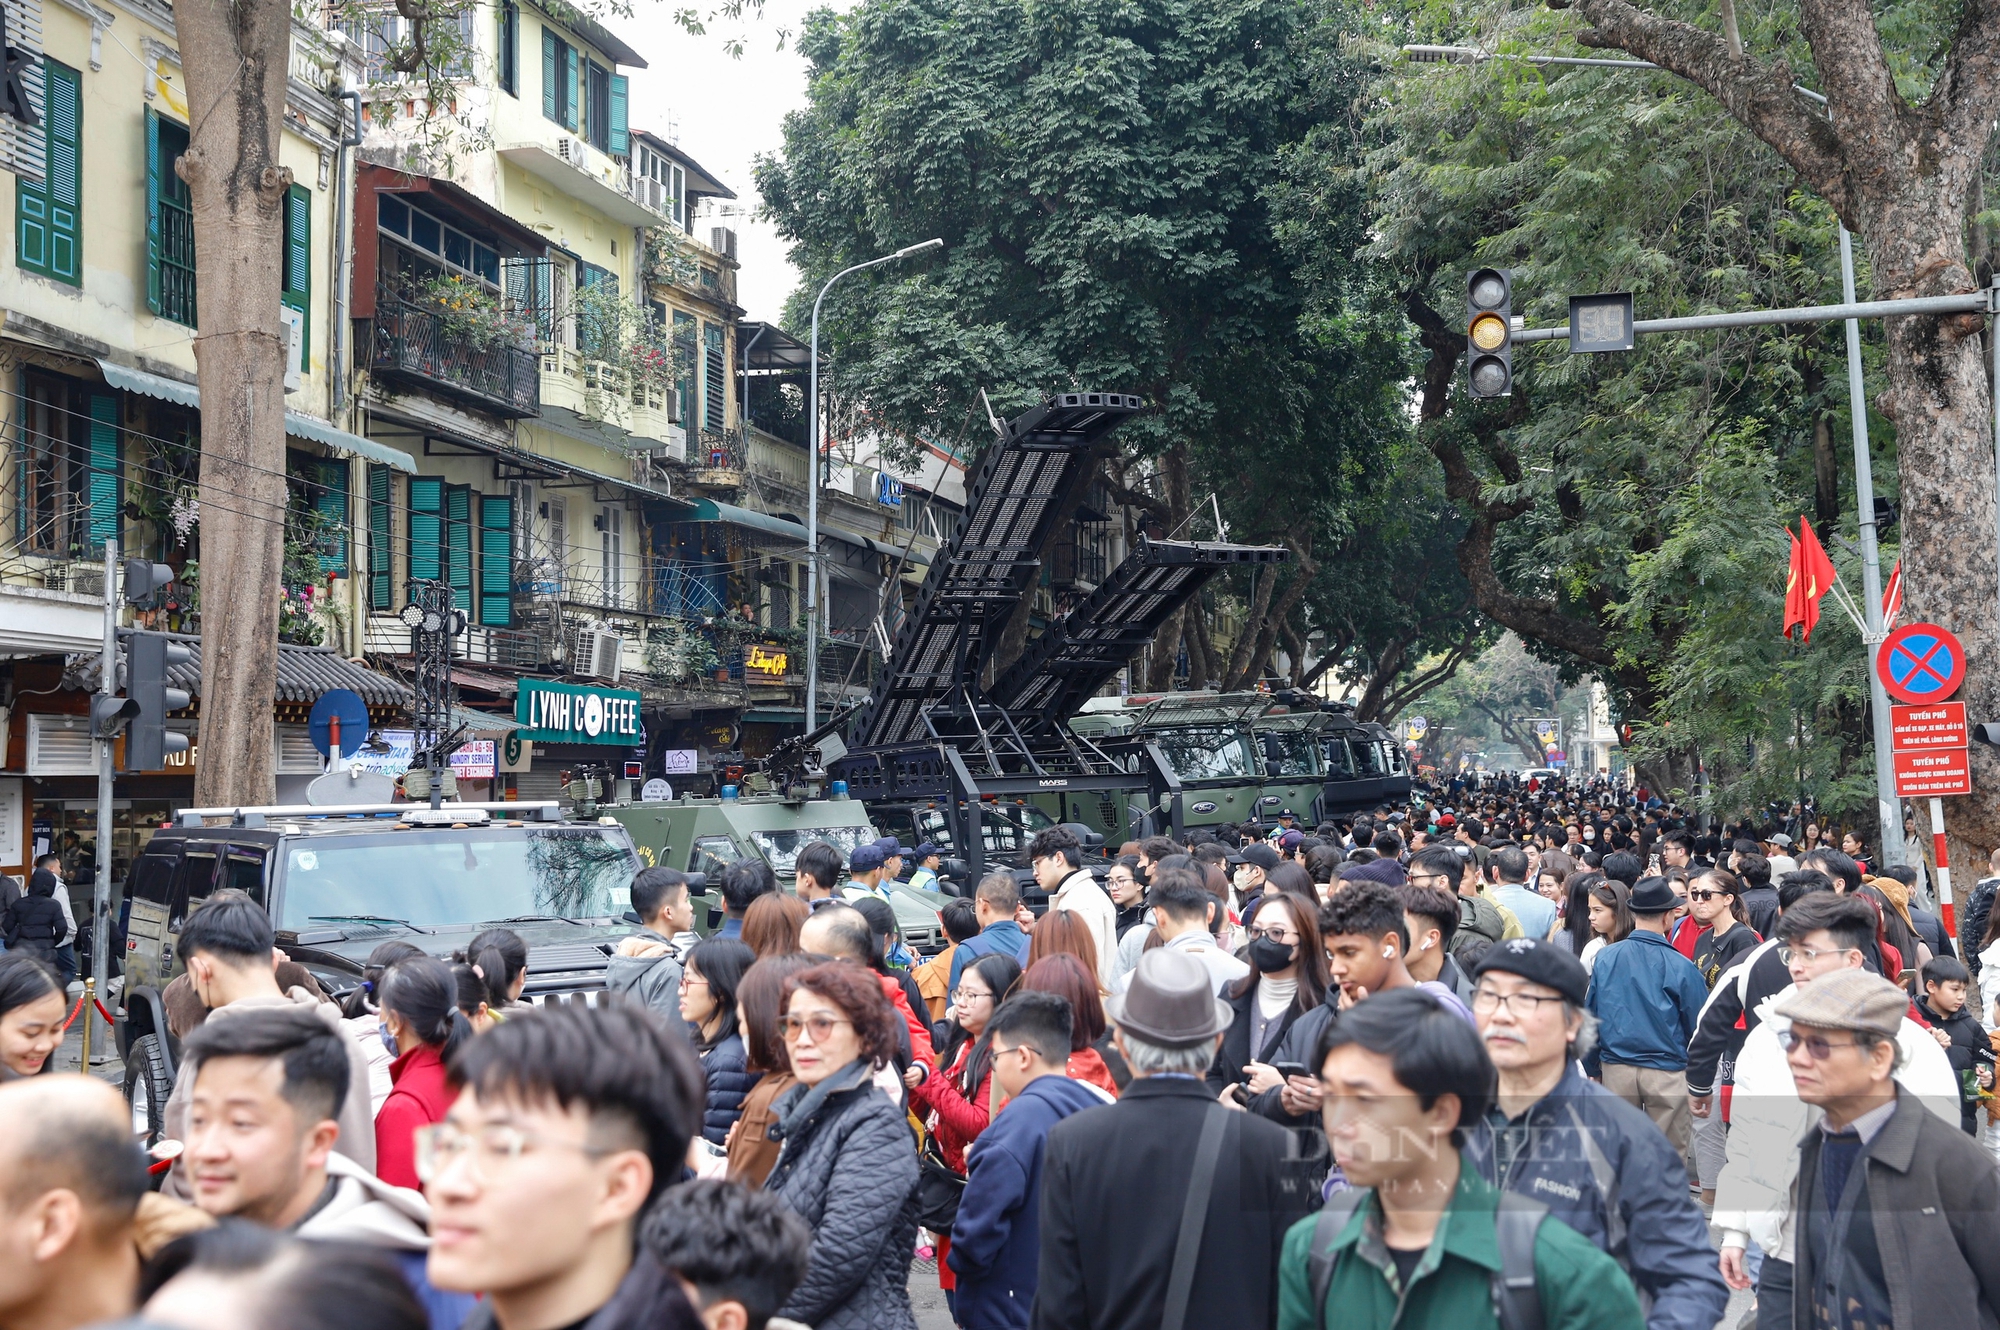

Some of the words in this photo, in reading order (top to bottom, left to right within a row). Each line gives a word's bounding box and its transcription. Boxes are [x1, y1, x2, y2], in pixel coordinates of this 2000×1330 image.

[530, 690, 570, 731] LYNH
[1909, 711, 1931, 720] TUYẾN
[1932, 709, 1947, 719] PHỐ
[510, 738, 517, 757] 5
[471, 754, 492, 764] SERVICE
[1912, 757, 1934, 766] TUYẾN
[1935, 755, 1950, 765] PHỐ
[467, 766, 494, 777] EXCHANGE
[1039, 779, 1068, 787] MARS
[1534, 1177, 1581, 1201] FASHION
